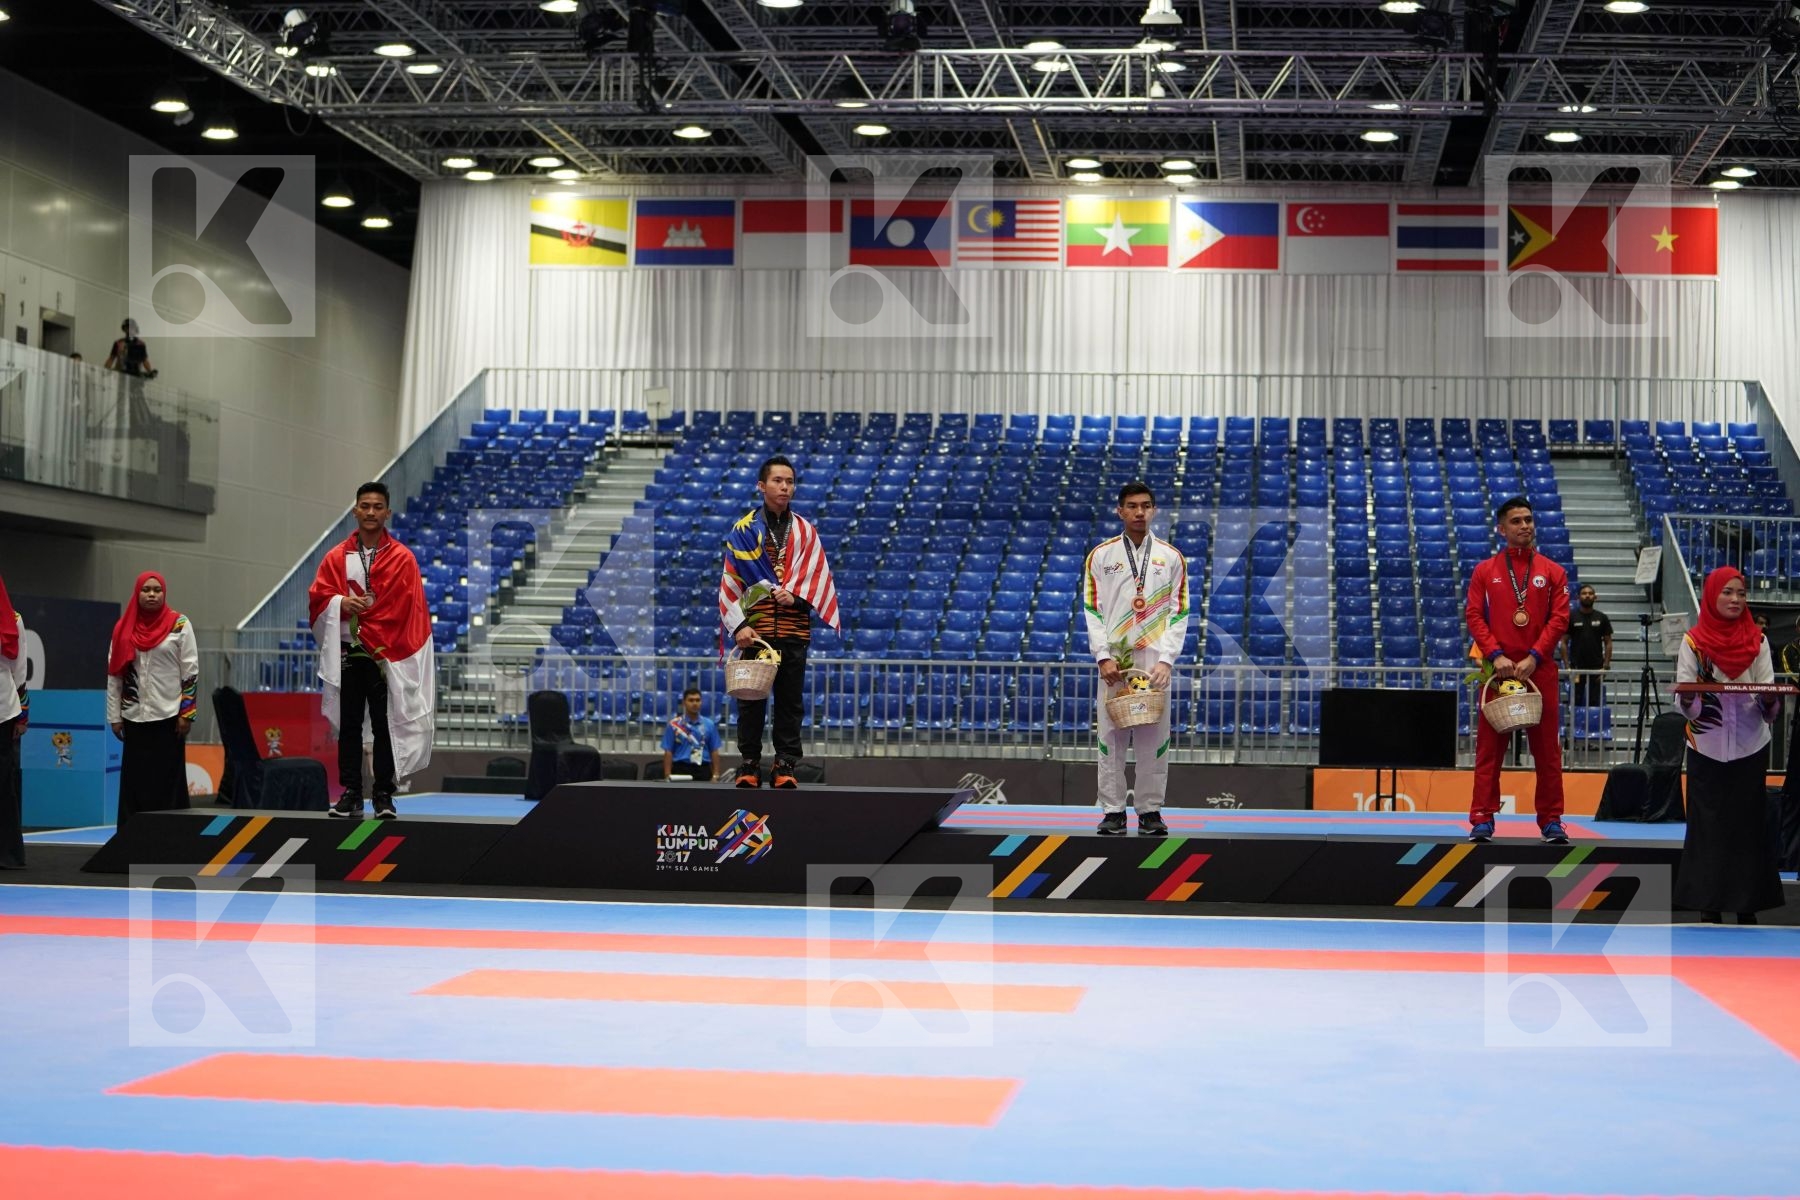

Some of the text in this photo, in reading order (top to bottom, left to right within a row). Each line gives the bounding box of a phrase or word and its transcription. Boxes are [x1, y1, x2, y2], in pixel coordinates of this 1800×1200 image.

[657, 824, 708, 837] KUALA
[656, 837, 719, 851] LUMPUR
[656, 850, 691, 863] 2017
